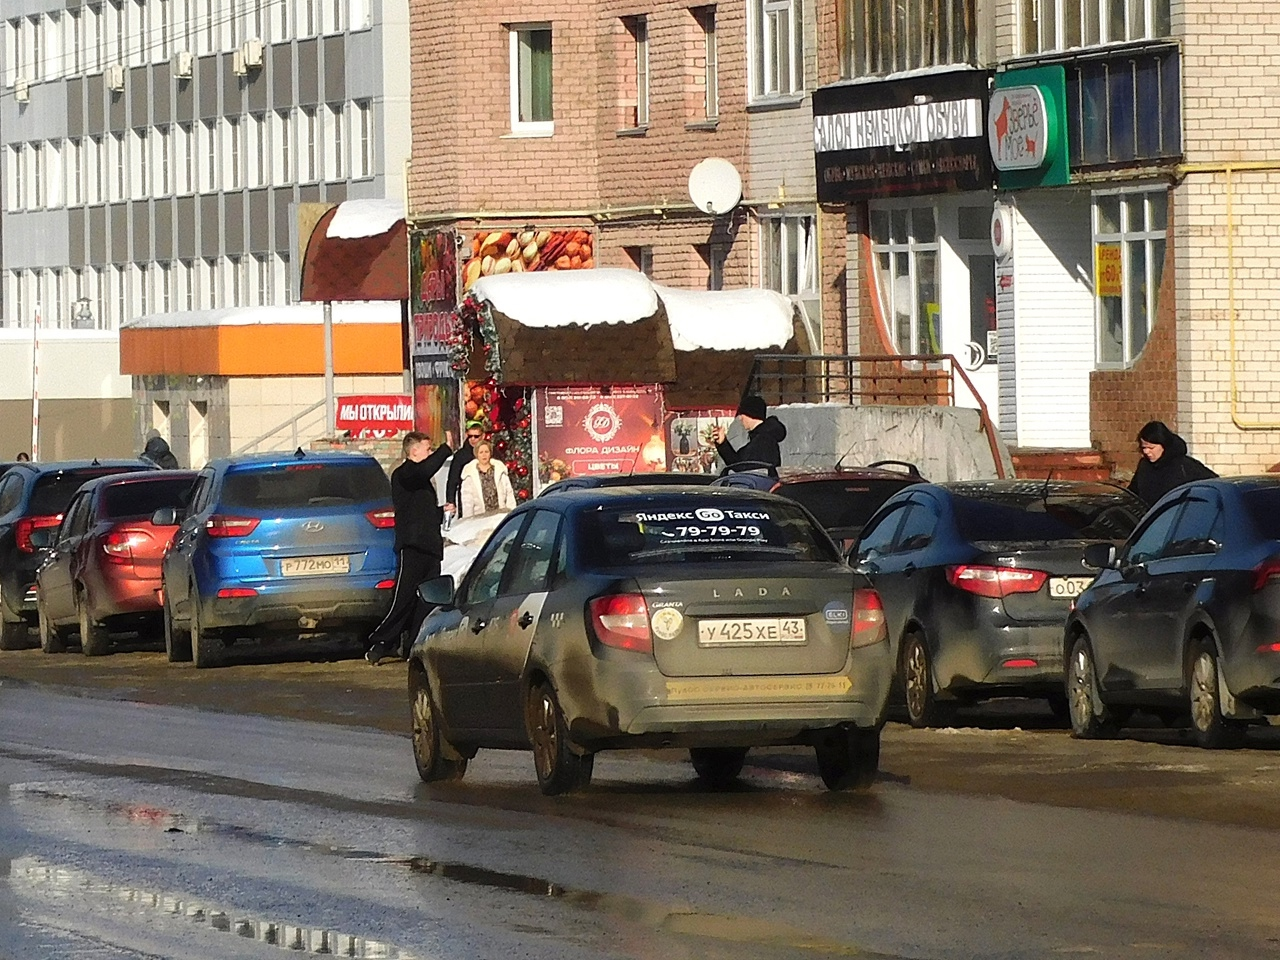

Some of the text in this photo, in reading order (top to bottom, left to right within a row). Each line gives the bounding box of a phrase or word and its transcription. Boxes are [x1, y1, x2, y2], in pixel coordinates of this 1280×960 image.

[926, 99, 971, 142] ОБУВИ
[340, 404, 413, 421] МЫ ОТКРЫЛИ
[565, 444, 640, 455] ФЛОРА ДИЗАЙН
[587, 463, 619, 472] ЦВЕТЫ
[636, 512, 694, 522] Яндекс
[724, 510, 770, 520] Такси
[675, 526, 761, 537] 79-79-79
[713, 587, 791, 598] LADA
